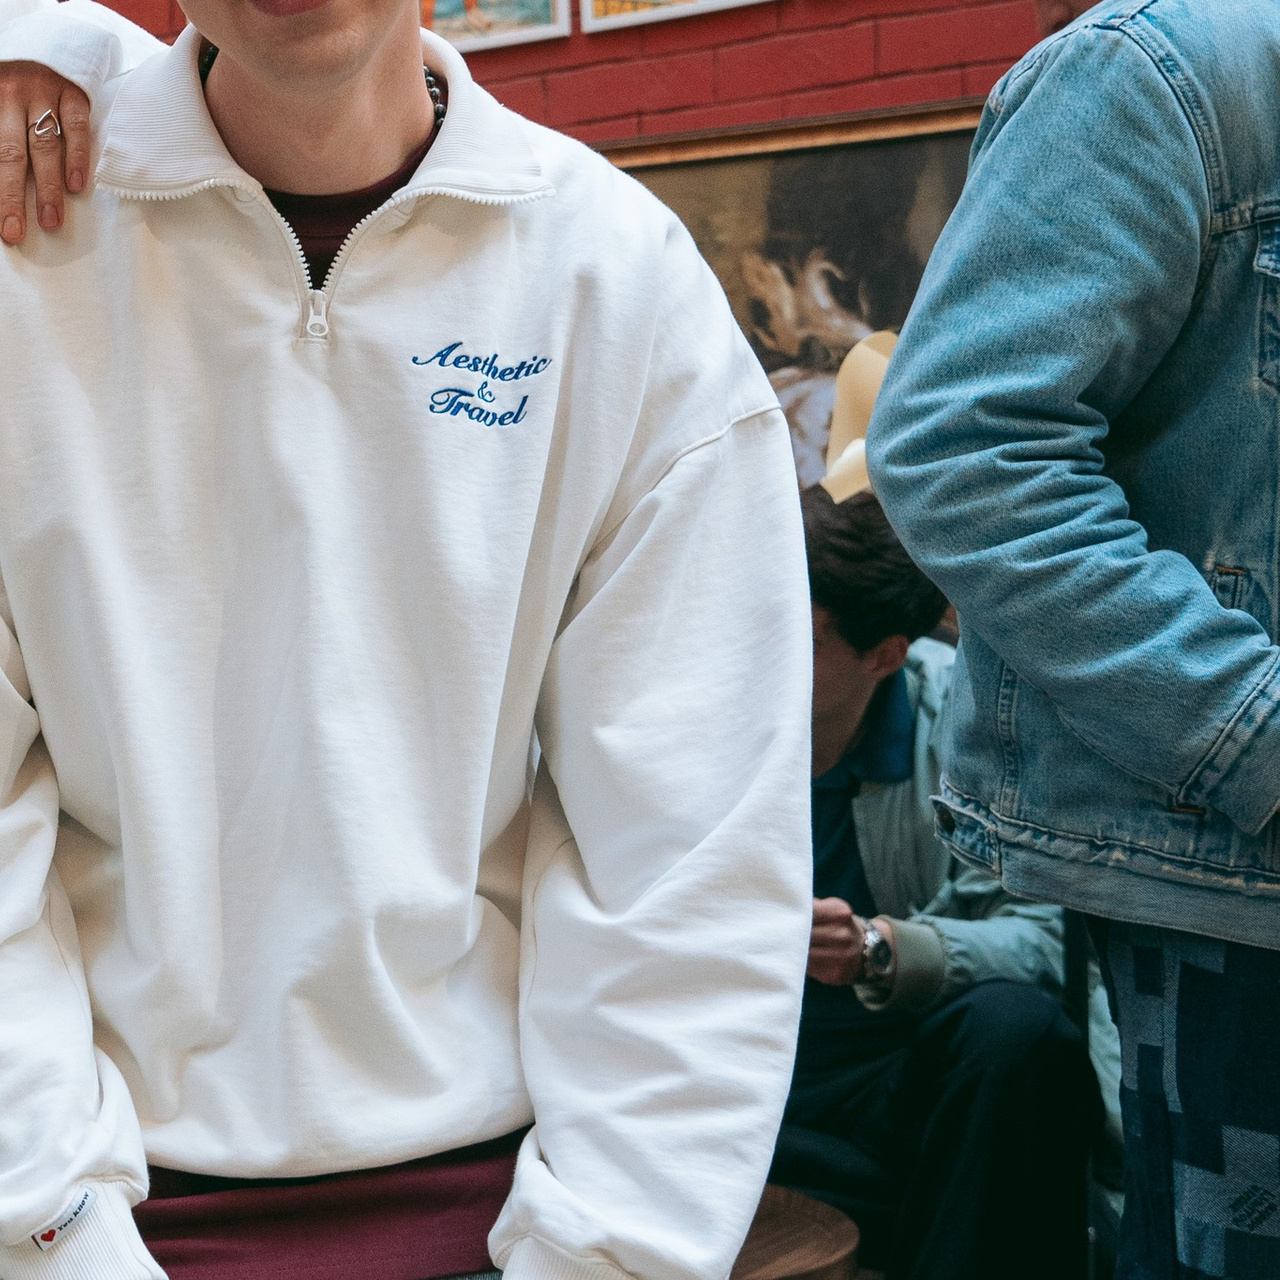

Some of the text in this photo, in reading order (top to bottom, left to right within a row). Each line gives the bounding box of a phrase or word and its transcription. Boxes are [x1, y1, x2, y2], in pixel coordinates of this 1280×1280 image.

[411, 341, 552, 382] Aesthetic
[429, 387, 529, 427] Travel
[477, 381, 496, 403] &
[56, 1217, 74, 1231] You
